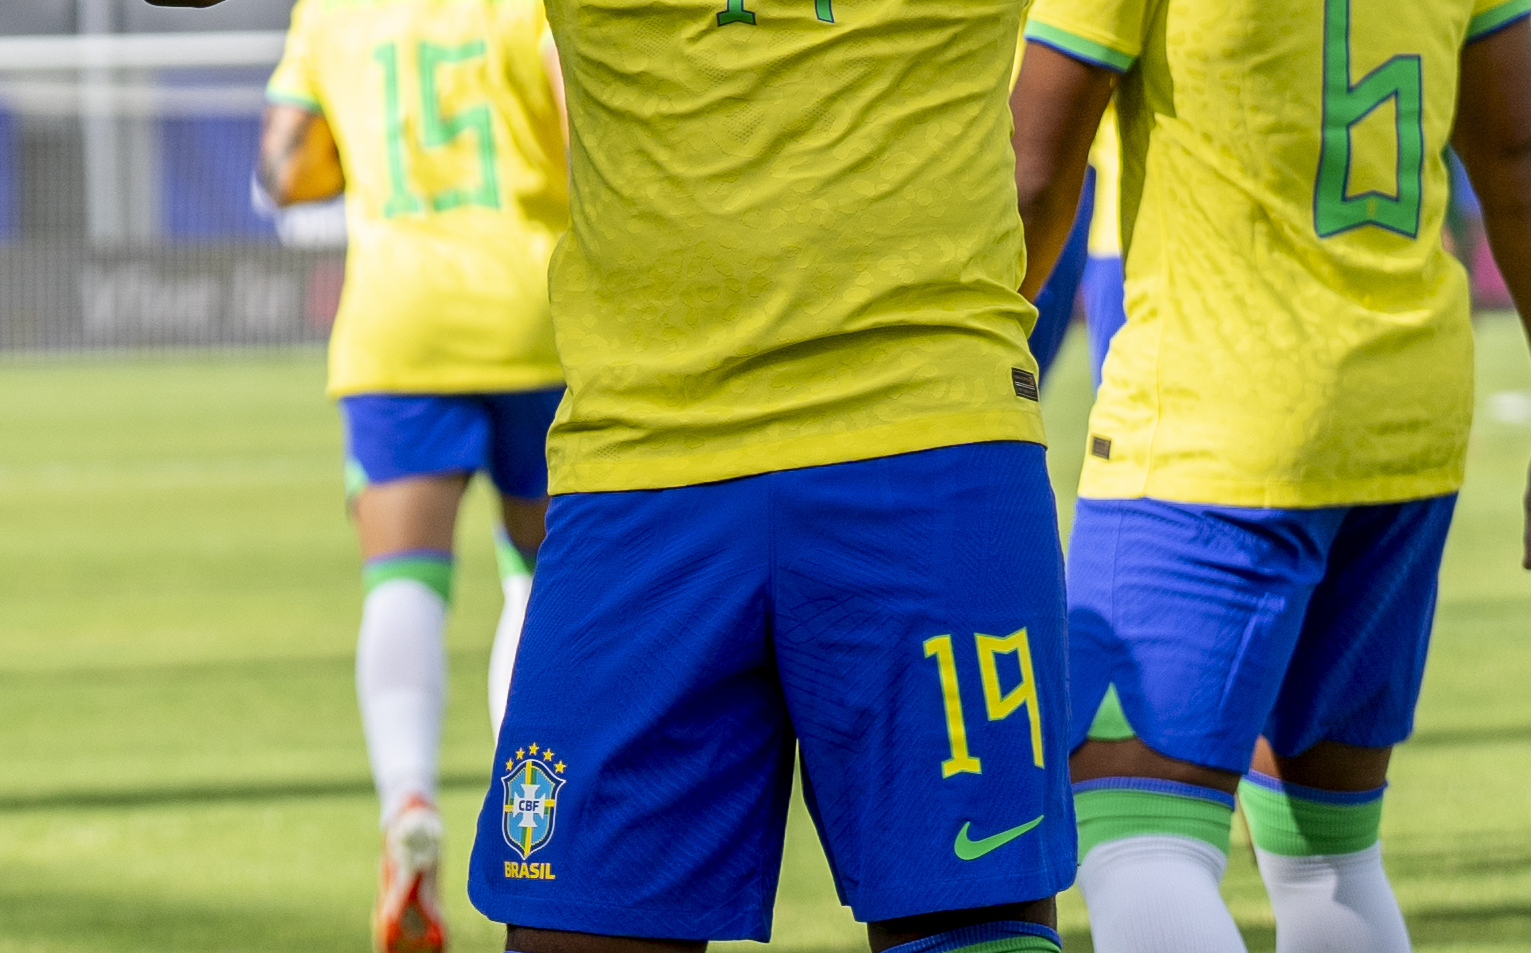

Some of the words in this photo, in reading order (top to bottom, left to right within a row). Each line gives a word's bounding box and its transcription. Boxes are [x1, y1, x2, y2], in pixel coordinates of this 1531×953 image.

[373, 39, 501, 220] 15
[923, 626, 1045, 779] 19
[518, 799, 540, 812] CBF
[504, 861, 556, 880] BRASIL
